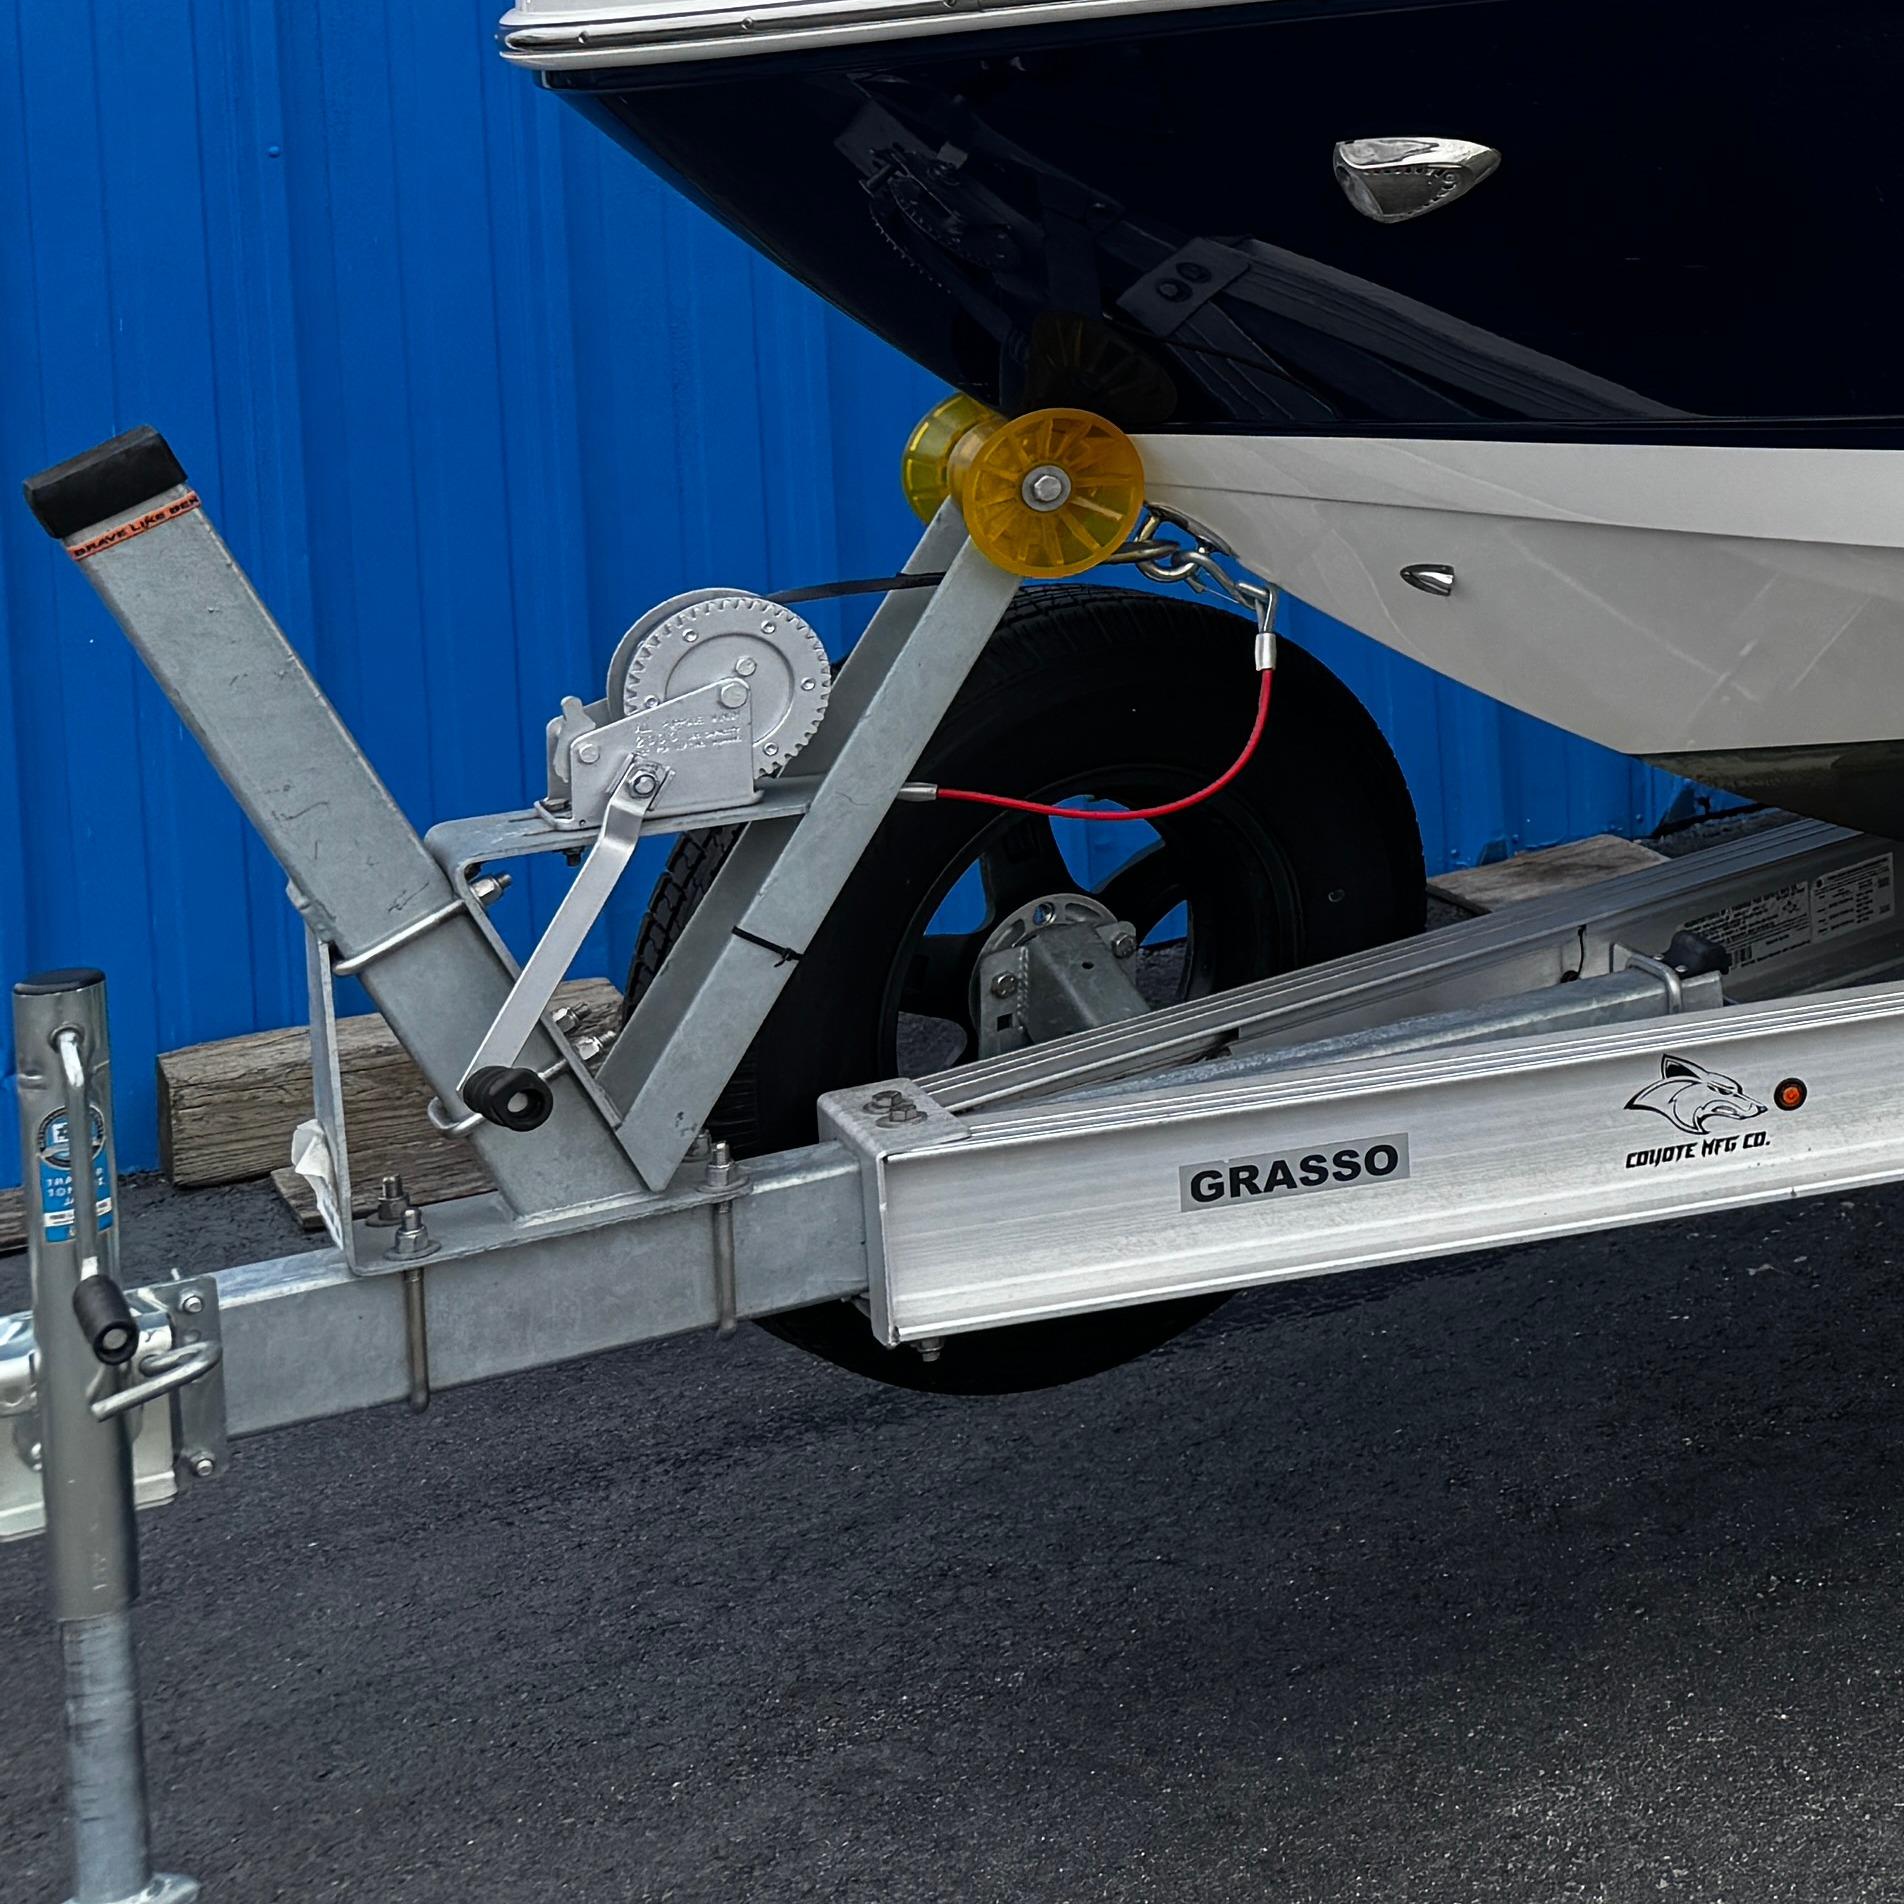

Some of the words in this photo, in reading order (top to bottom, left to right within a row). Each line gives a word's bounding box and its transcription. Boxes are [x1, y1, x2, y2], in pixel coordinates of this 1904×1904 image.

[1188, 1142, 1400, 1206] GRASSO
[1625, 1141, 1699, 1169] COYOTE
[1700, 1133, 1742, 1158] MFG
[1742, 1130, 1771, 1150] CO.
